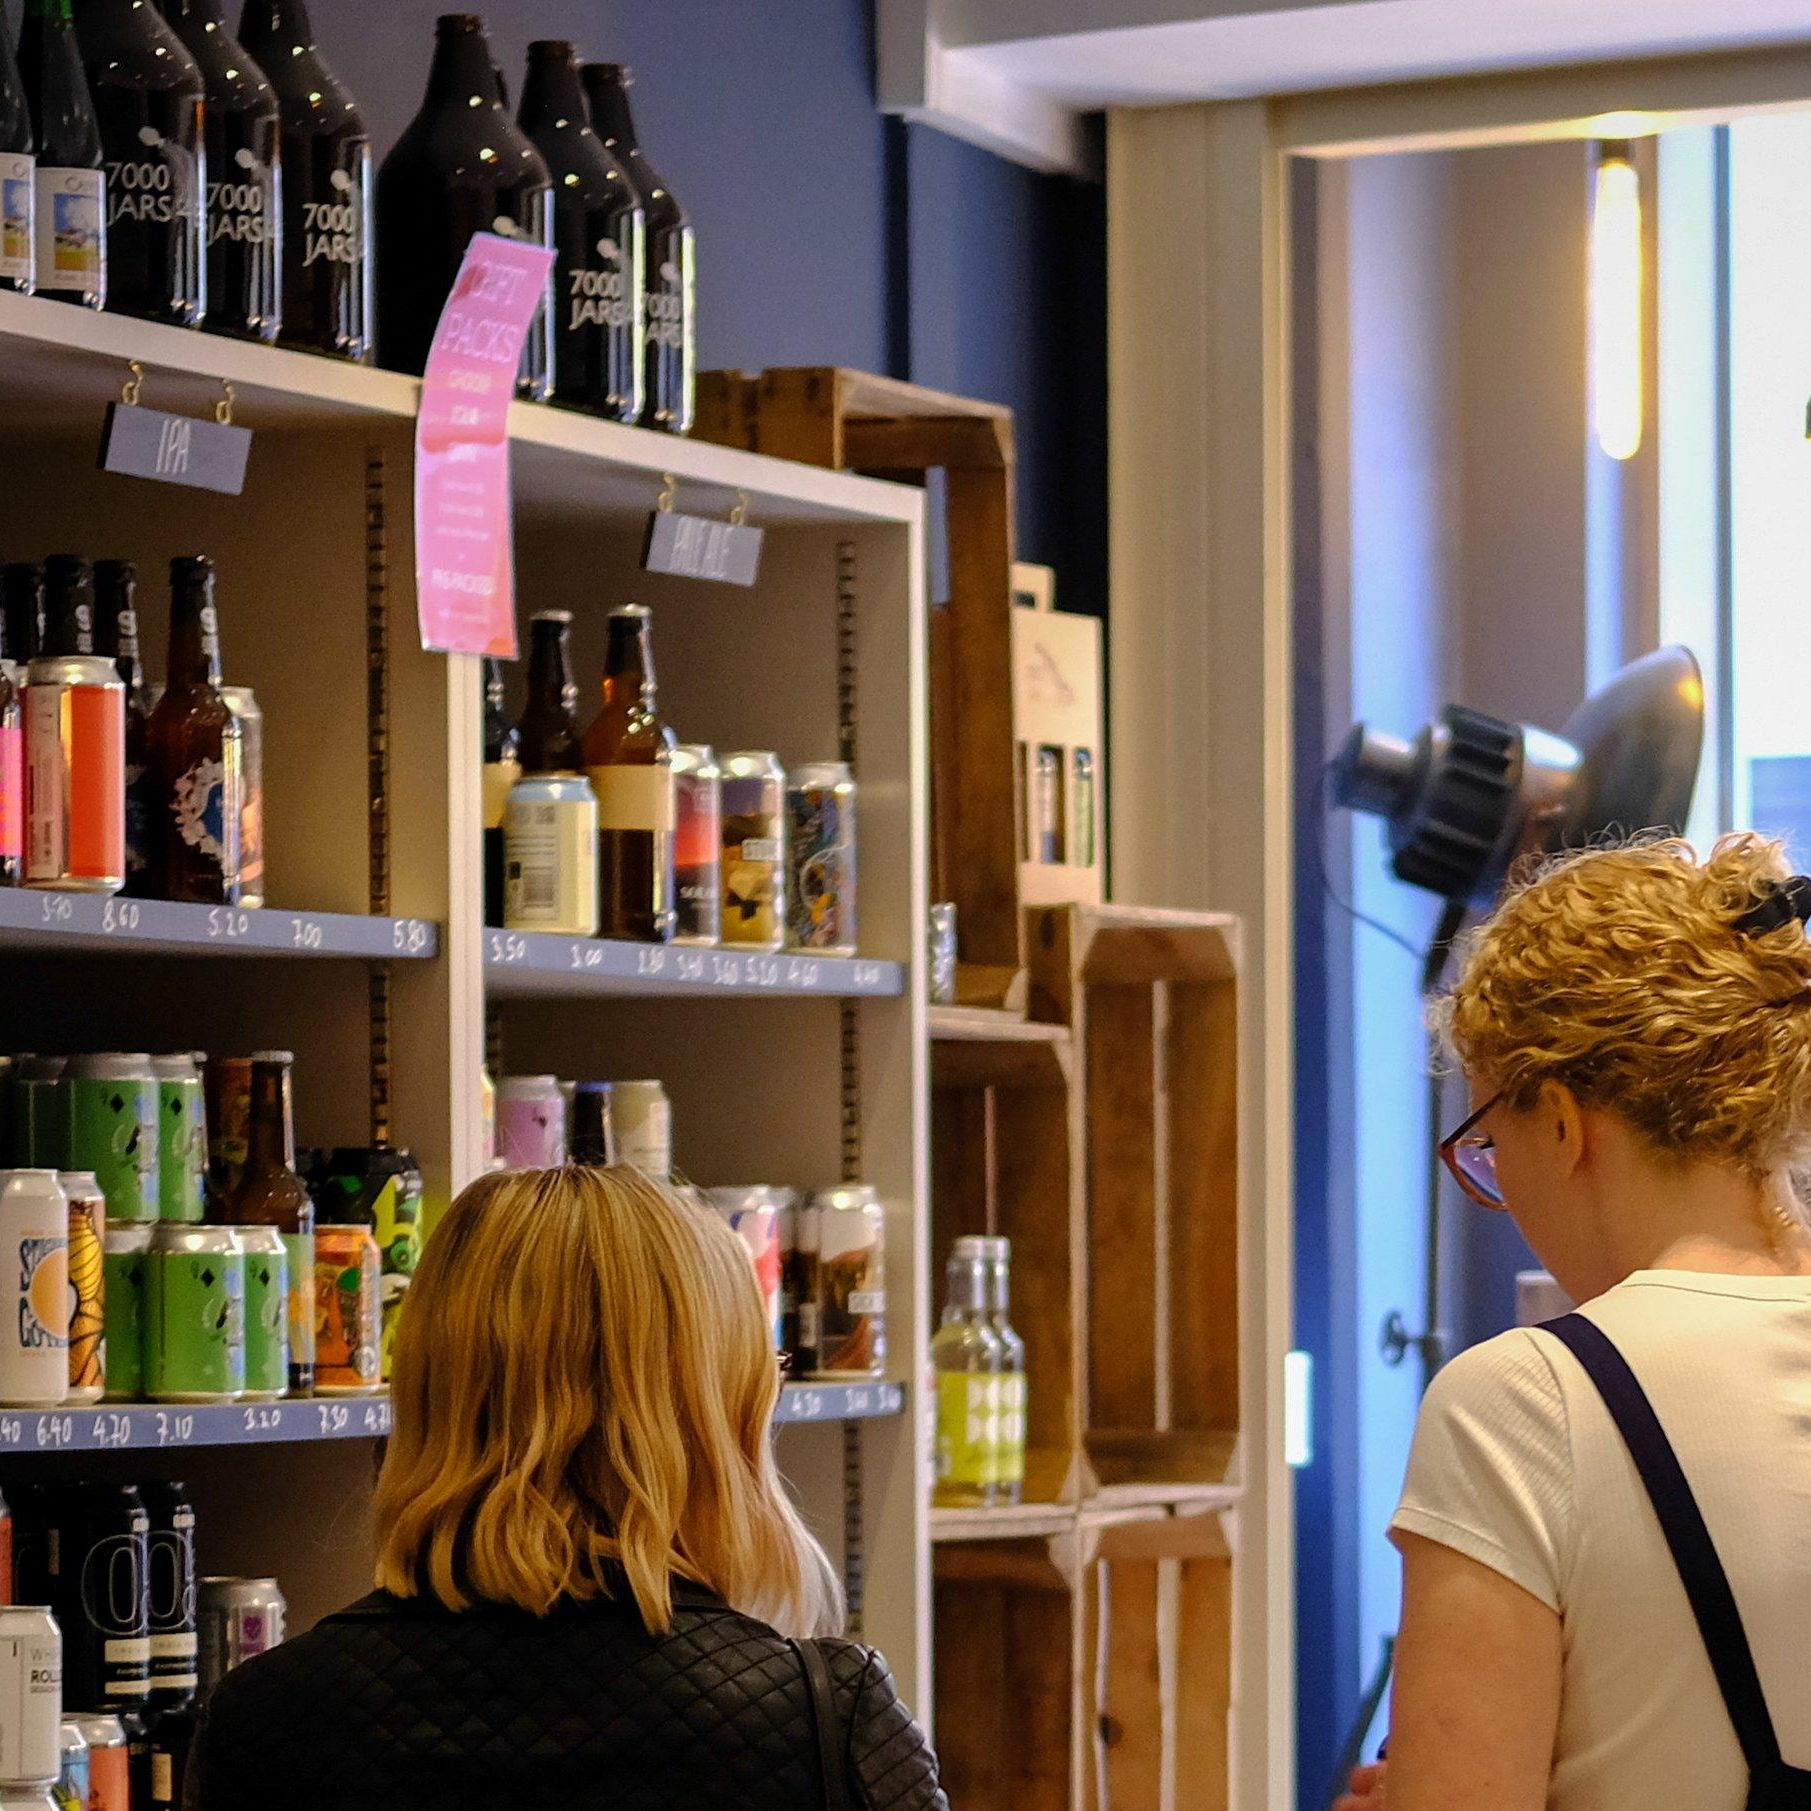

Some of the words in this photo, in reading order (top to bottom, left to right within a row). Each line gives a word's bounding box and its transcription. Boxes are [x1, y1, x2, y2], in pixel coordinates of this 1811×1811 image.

[106, 161, 171, 192] 7000
[106, 195, 172, 227] JARS
[207, 184, 263, 213] 7000
[206, 216, 264, 248] JARS
[303, 204, 355, 234] 7000
[155, 418, 192, 475] IPA
